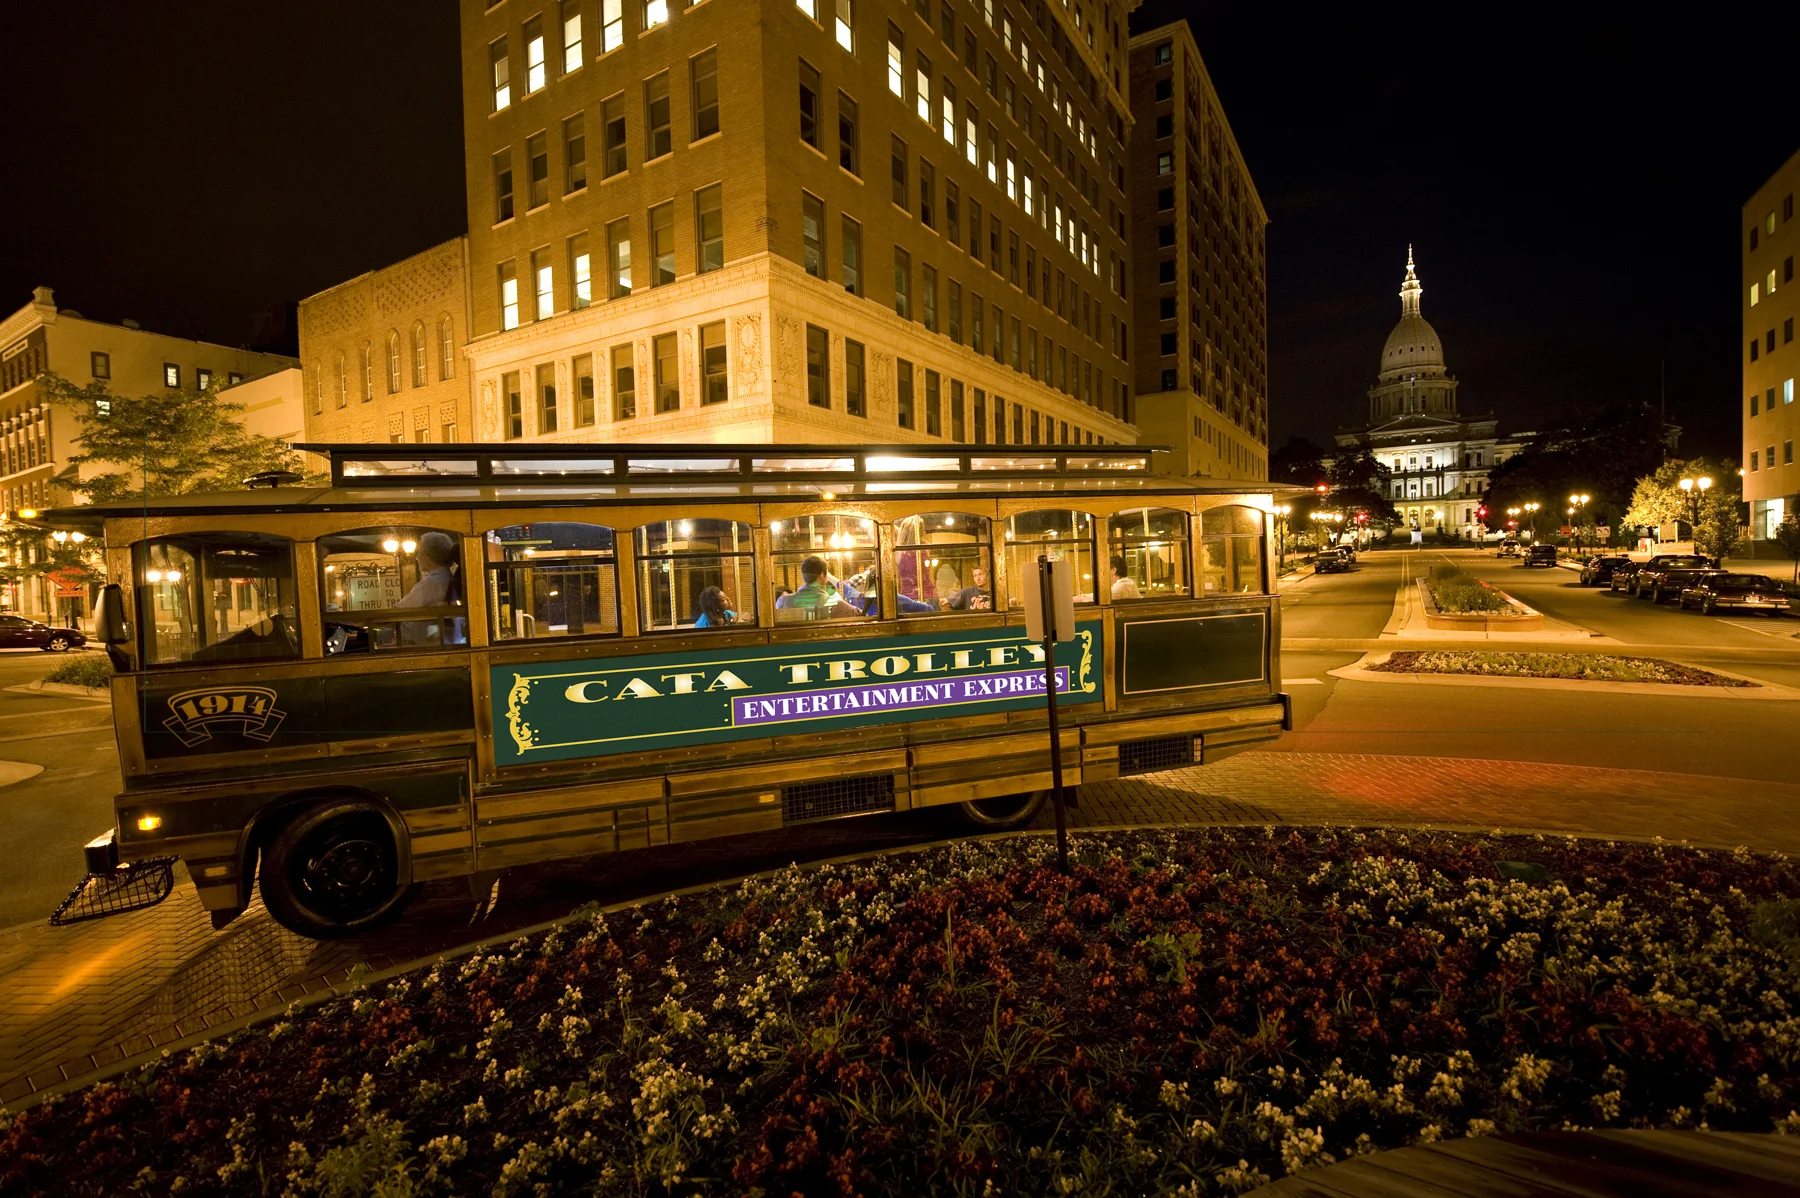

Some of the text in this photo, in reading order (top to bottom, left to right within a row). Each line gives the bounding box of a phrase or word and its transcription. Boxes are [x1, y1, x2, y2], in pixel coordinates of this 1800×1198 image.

[357, 578, 400, 589] ROAD CLO
[385, 589, 394, 597] TO
[359, 599, 382, 610] THRU
[565, 643, 1058, 703] CATA TROLLEY
[743, 672, 1064, 719] ENTERTAINMENT EXPRESS
[177, 695, 267, 720] 1914
